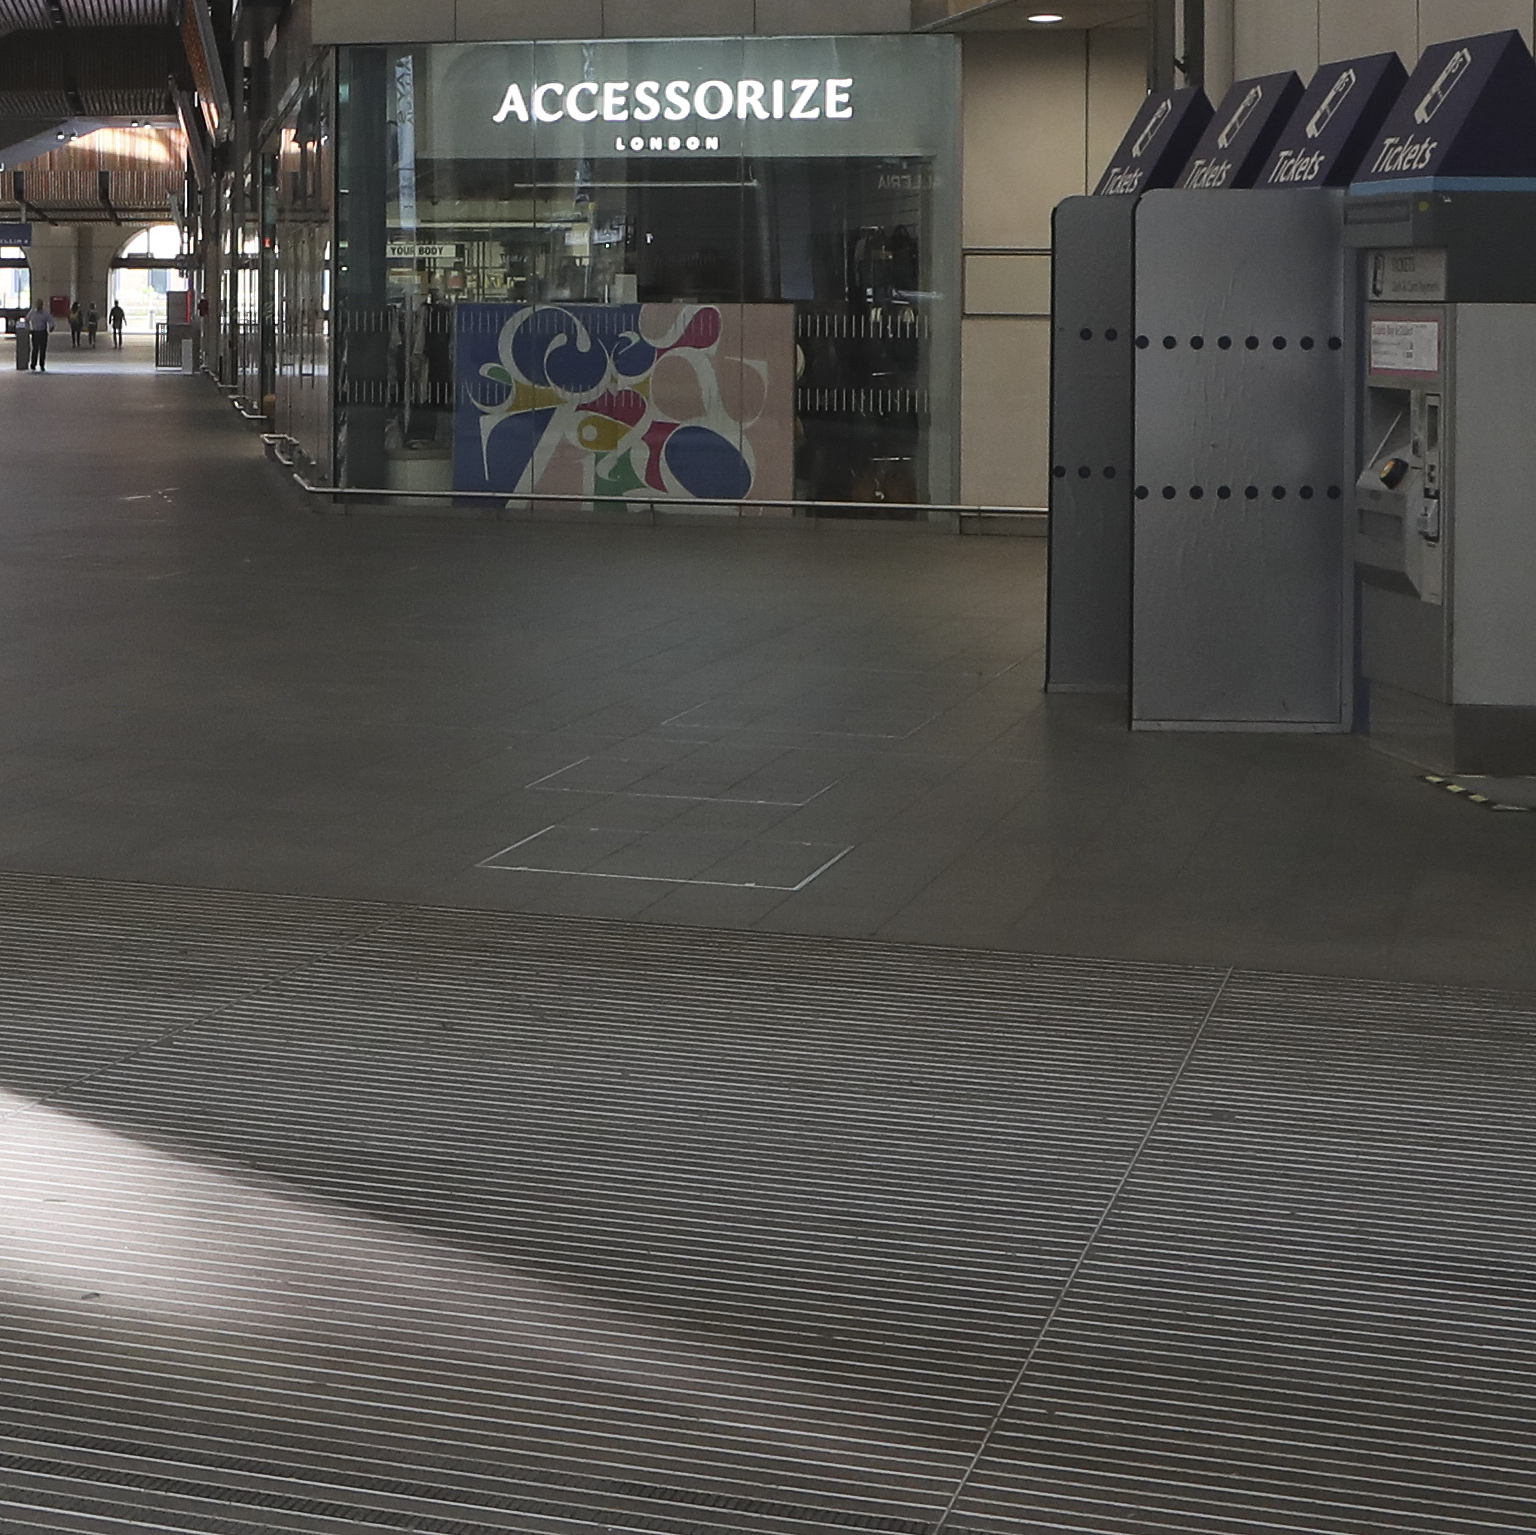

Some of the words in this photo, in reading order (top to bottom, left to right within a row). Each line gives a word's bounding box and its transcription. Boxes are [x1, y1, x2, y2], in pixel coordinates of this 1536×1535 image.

[493, 78, 853, 122] ACCESSORIZE
[616, 137, 720, 151] LONDON
[1371, 133, 1438, 175] Tickets
[1101, 165, 1144, 196] Tickets
[1184, 157, 1232, 189] Tickets
[1267, 147, 1326, 184] Tickets
[418, 247, 444, 256] BODY
